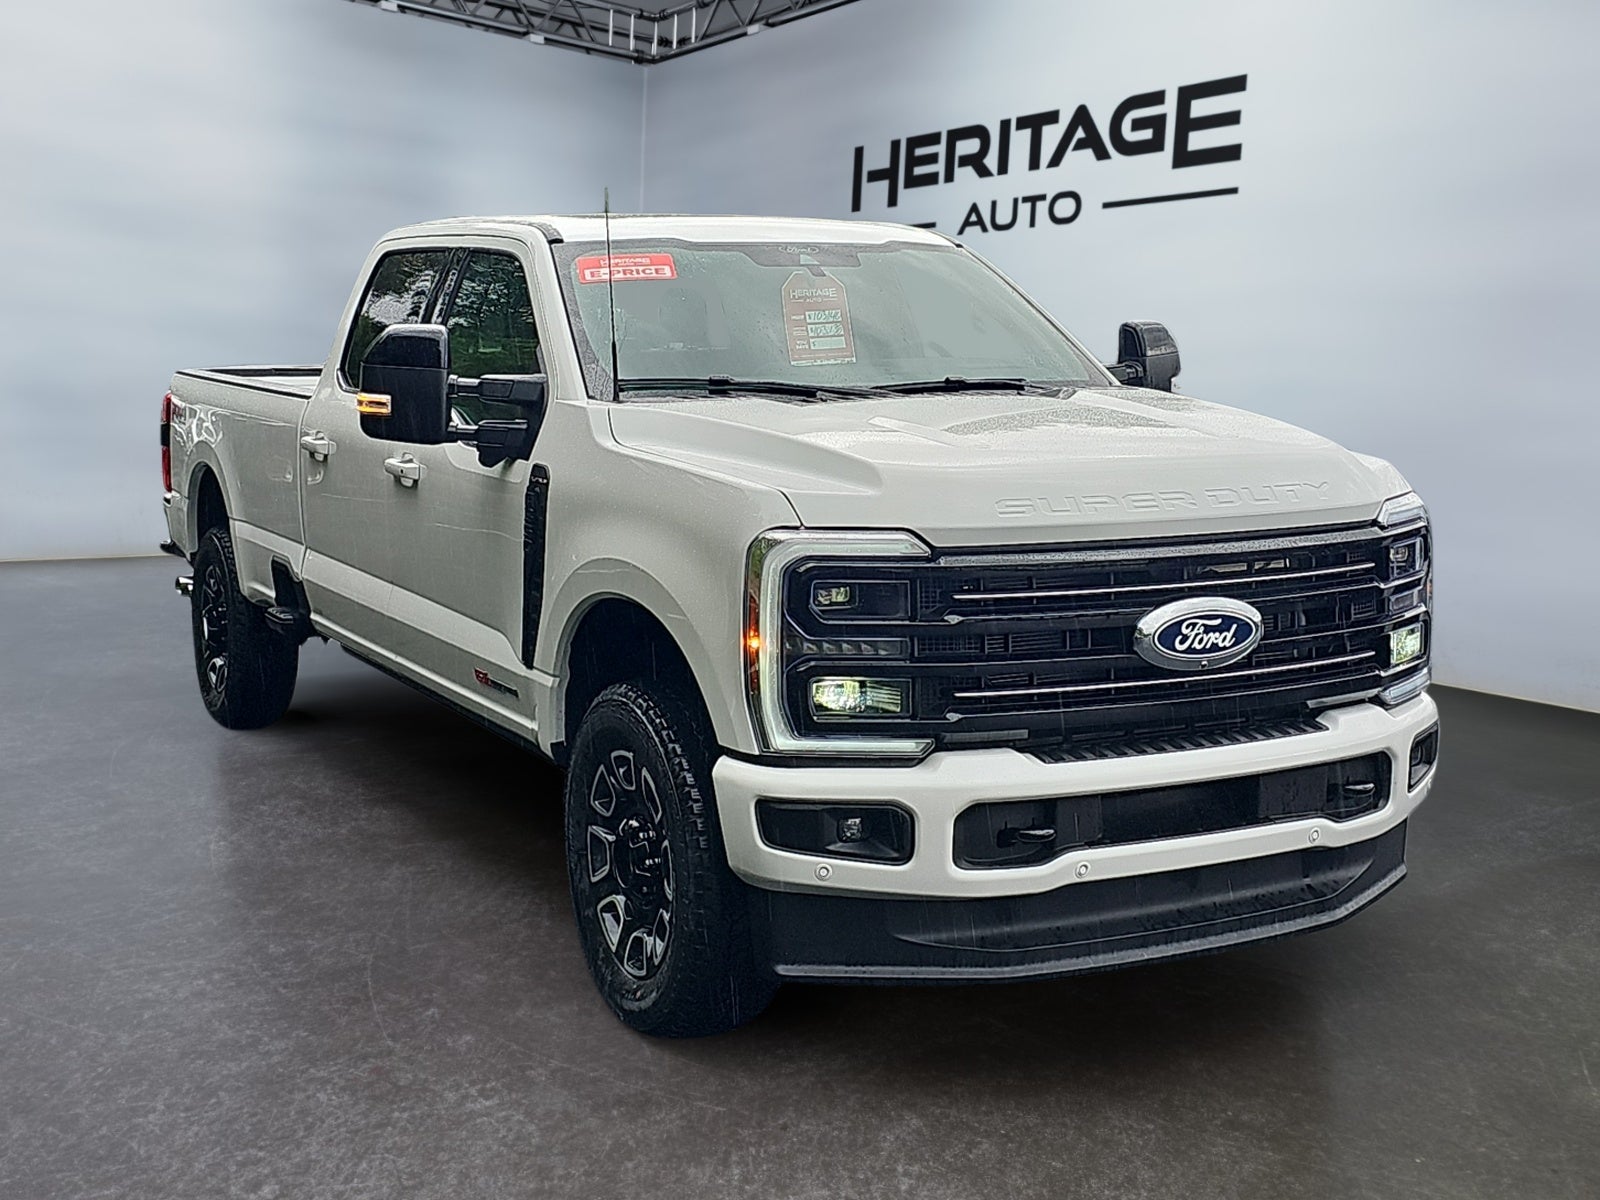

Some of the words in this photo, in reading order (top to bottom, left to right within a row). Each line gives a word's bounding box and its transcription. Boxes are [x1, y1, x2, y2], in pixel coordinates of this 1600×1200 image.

[851, 73, 1248, 213] HERITAGE
[957, 190, 1083, 236] AUTO
[589, 267, 667, 278] E-PRICE
[789, 288, 838, 299] HERITAGE
[995, 491, 1198, 517] SUPER
[1204, 481, 1328, 508] DUTY
[1174, 617, 1238, 651] Ford
